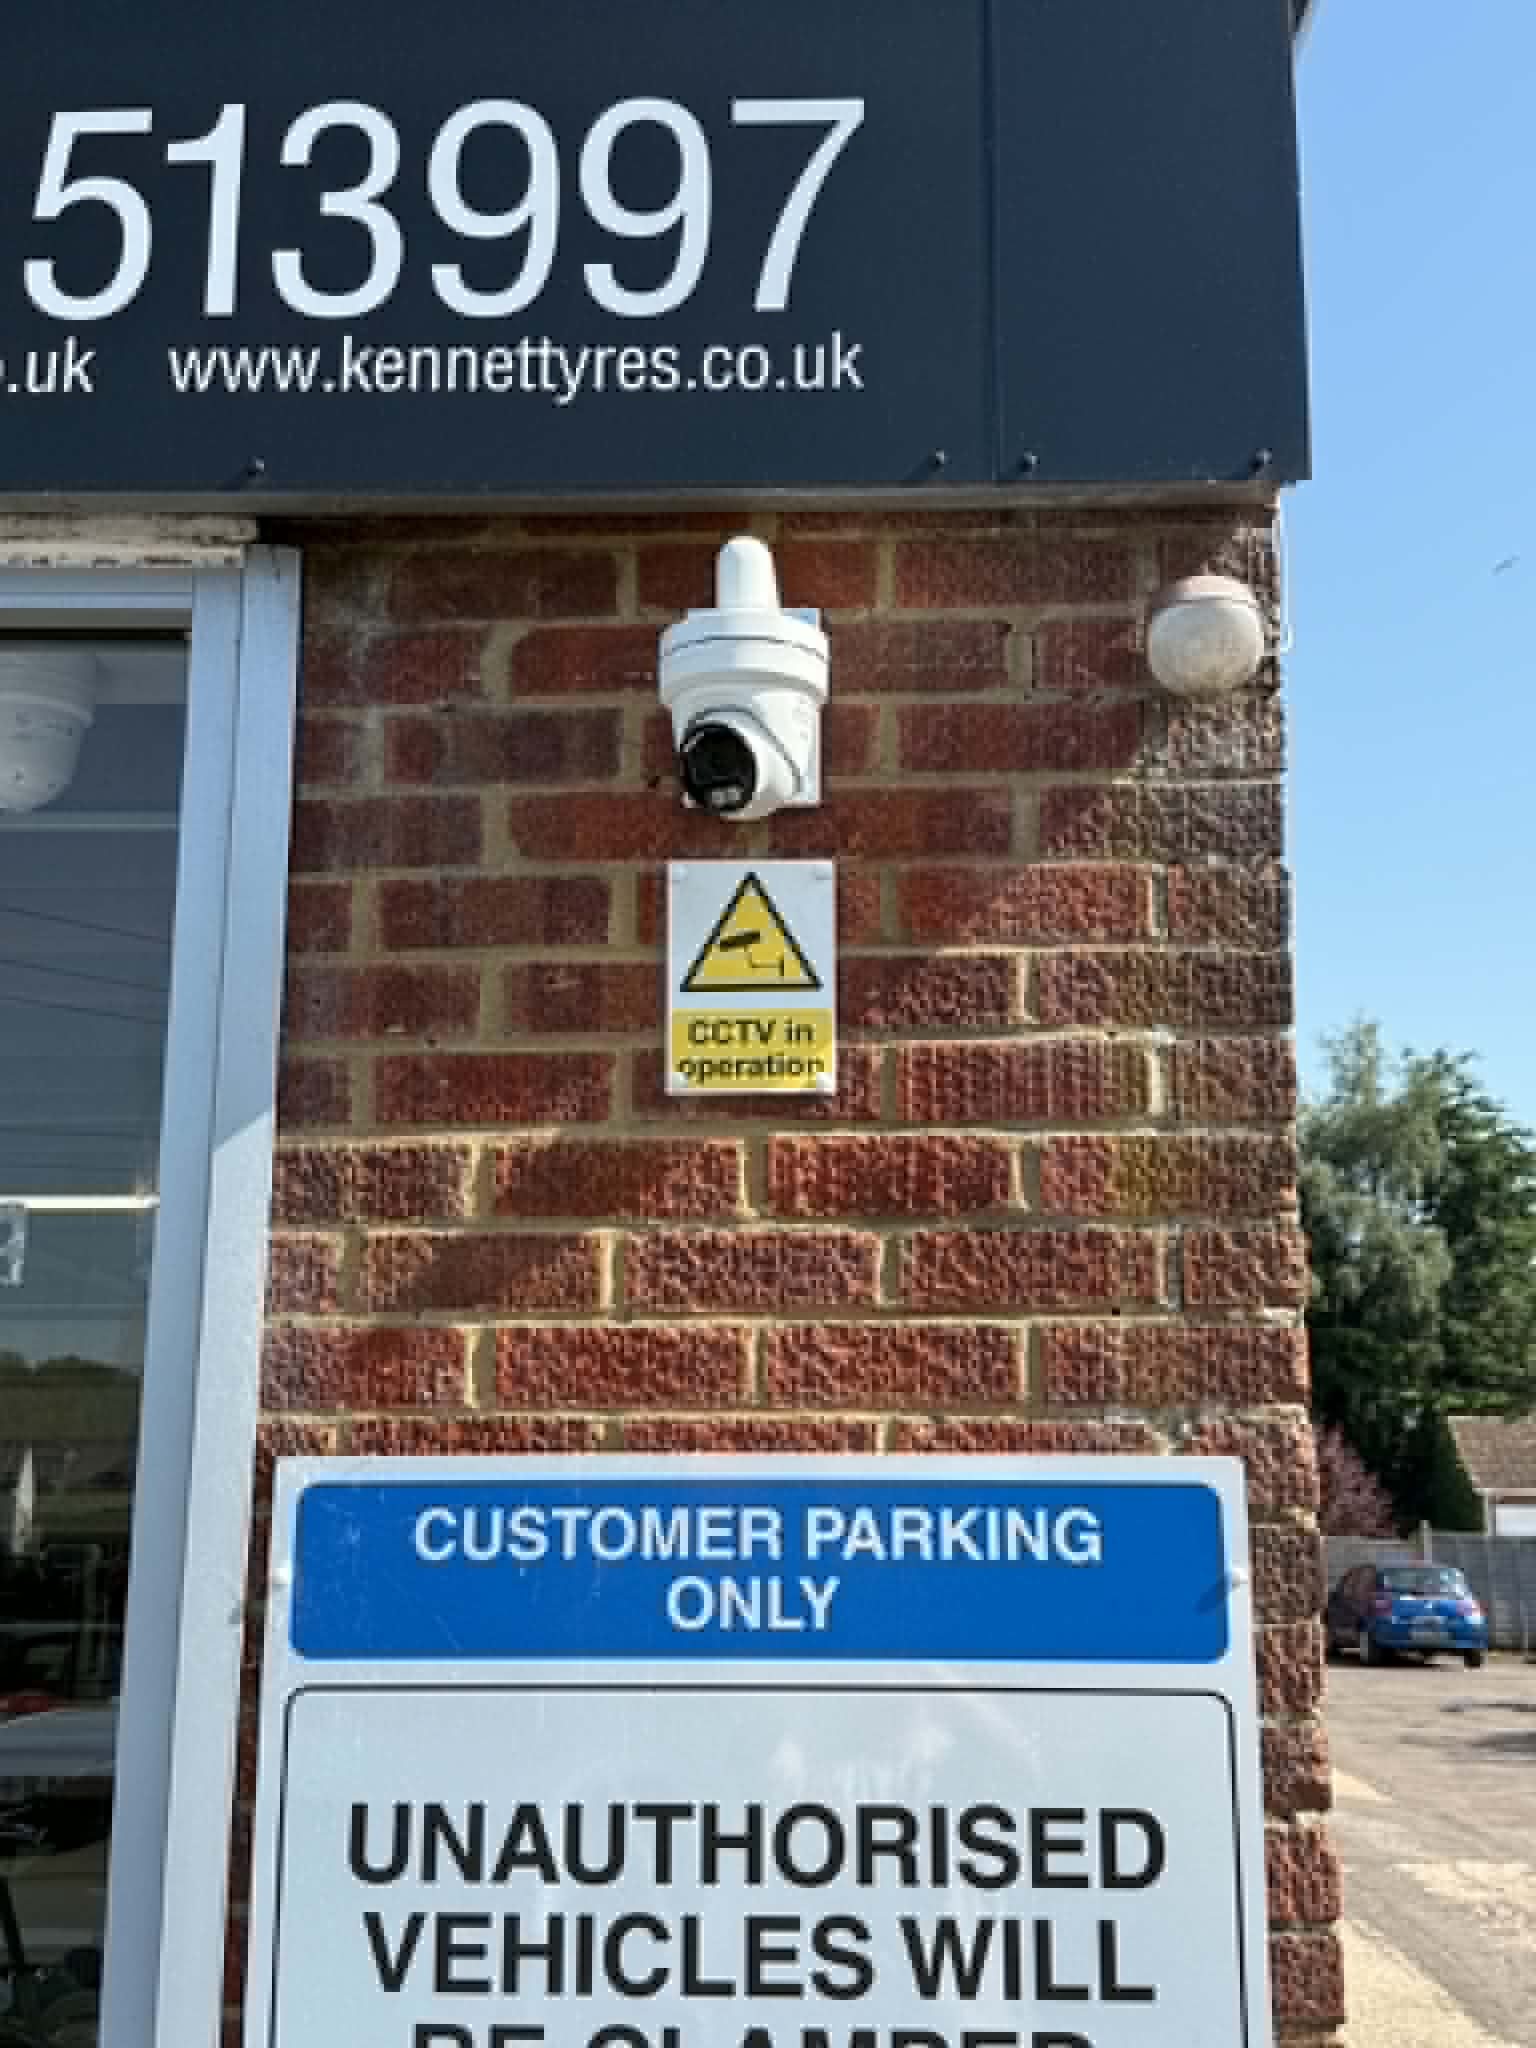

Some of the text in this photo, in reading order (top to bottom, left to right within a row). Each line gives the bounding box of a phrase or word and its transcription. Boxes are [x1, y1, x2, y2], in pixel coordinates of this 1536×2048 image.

[23, 97, 865, 321] 513997
[0, 331, 864, 406] .uk www.kennettyres.co.uk
[688, 1018, 816, 1045] CCTV in
[678, 1053, 825, 1086] operation
[413, 1506, 1104, 1564] CUSTOMER PARKING
[665, 1576, 841, 1632] ONLY
[347, 1802, 1165, 1891] UNAUTHORISED
[363, 1912, 1156, 2001] VEHICLES WILL
